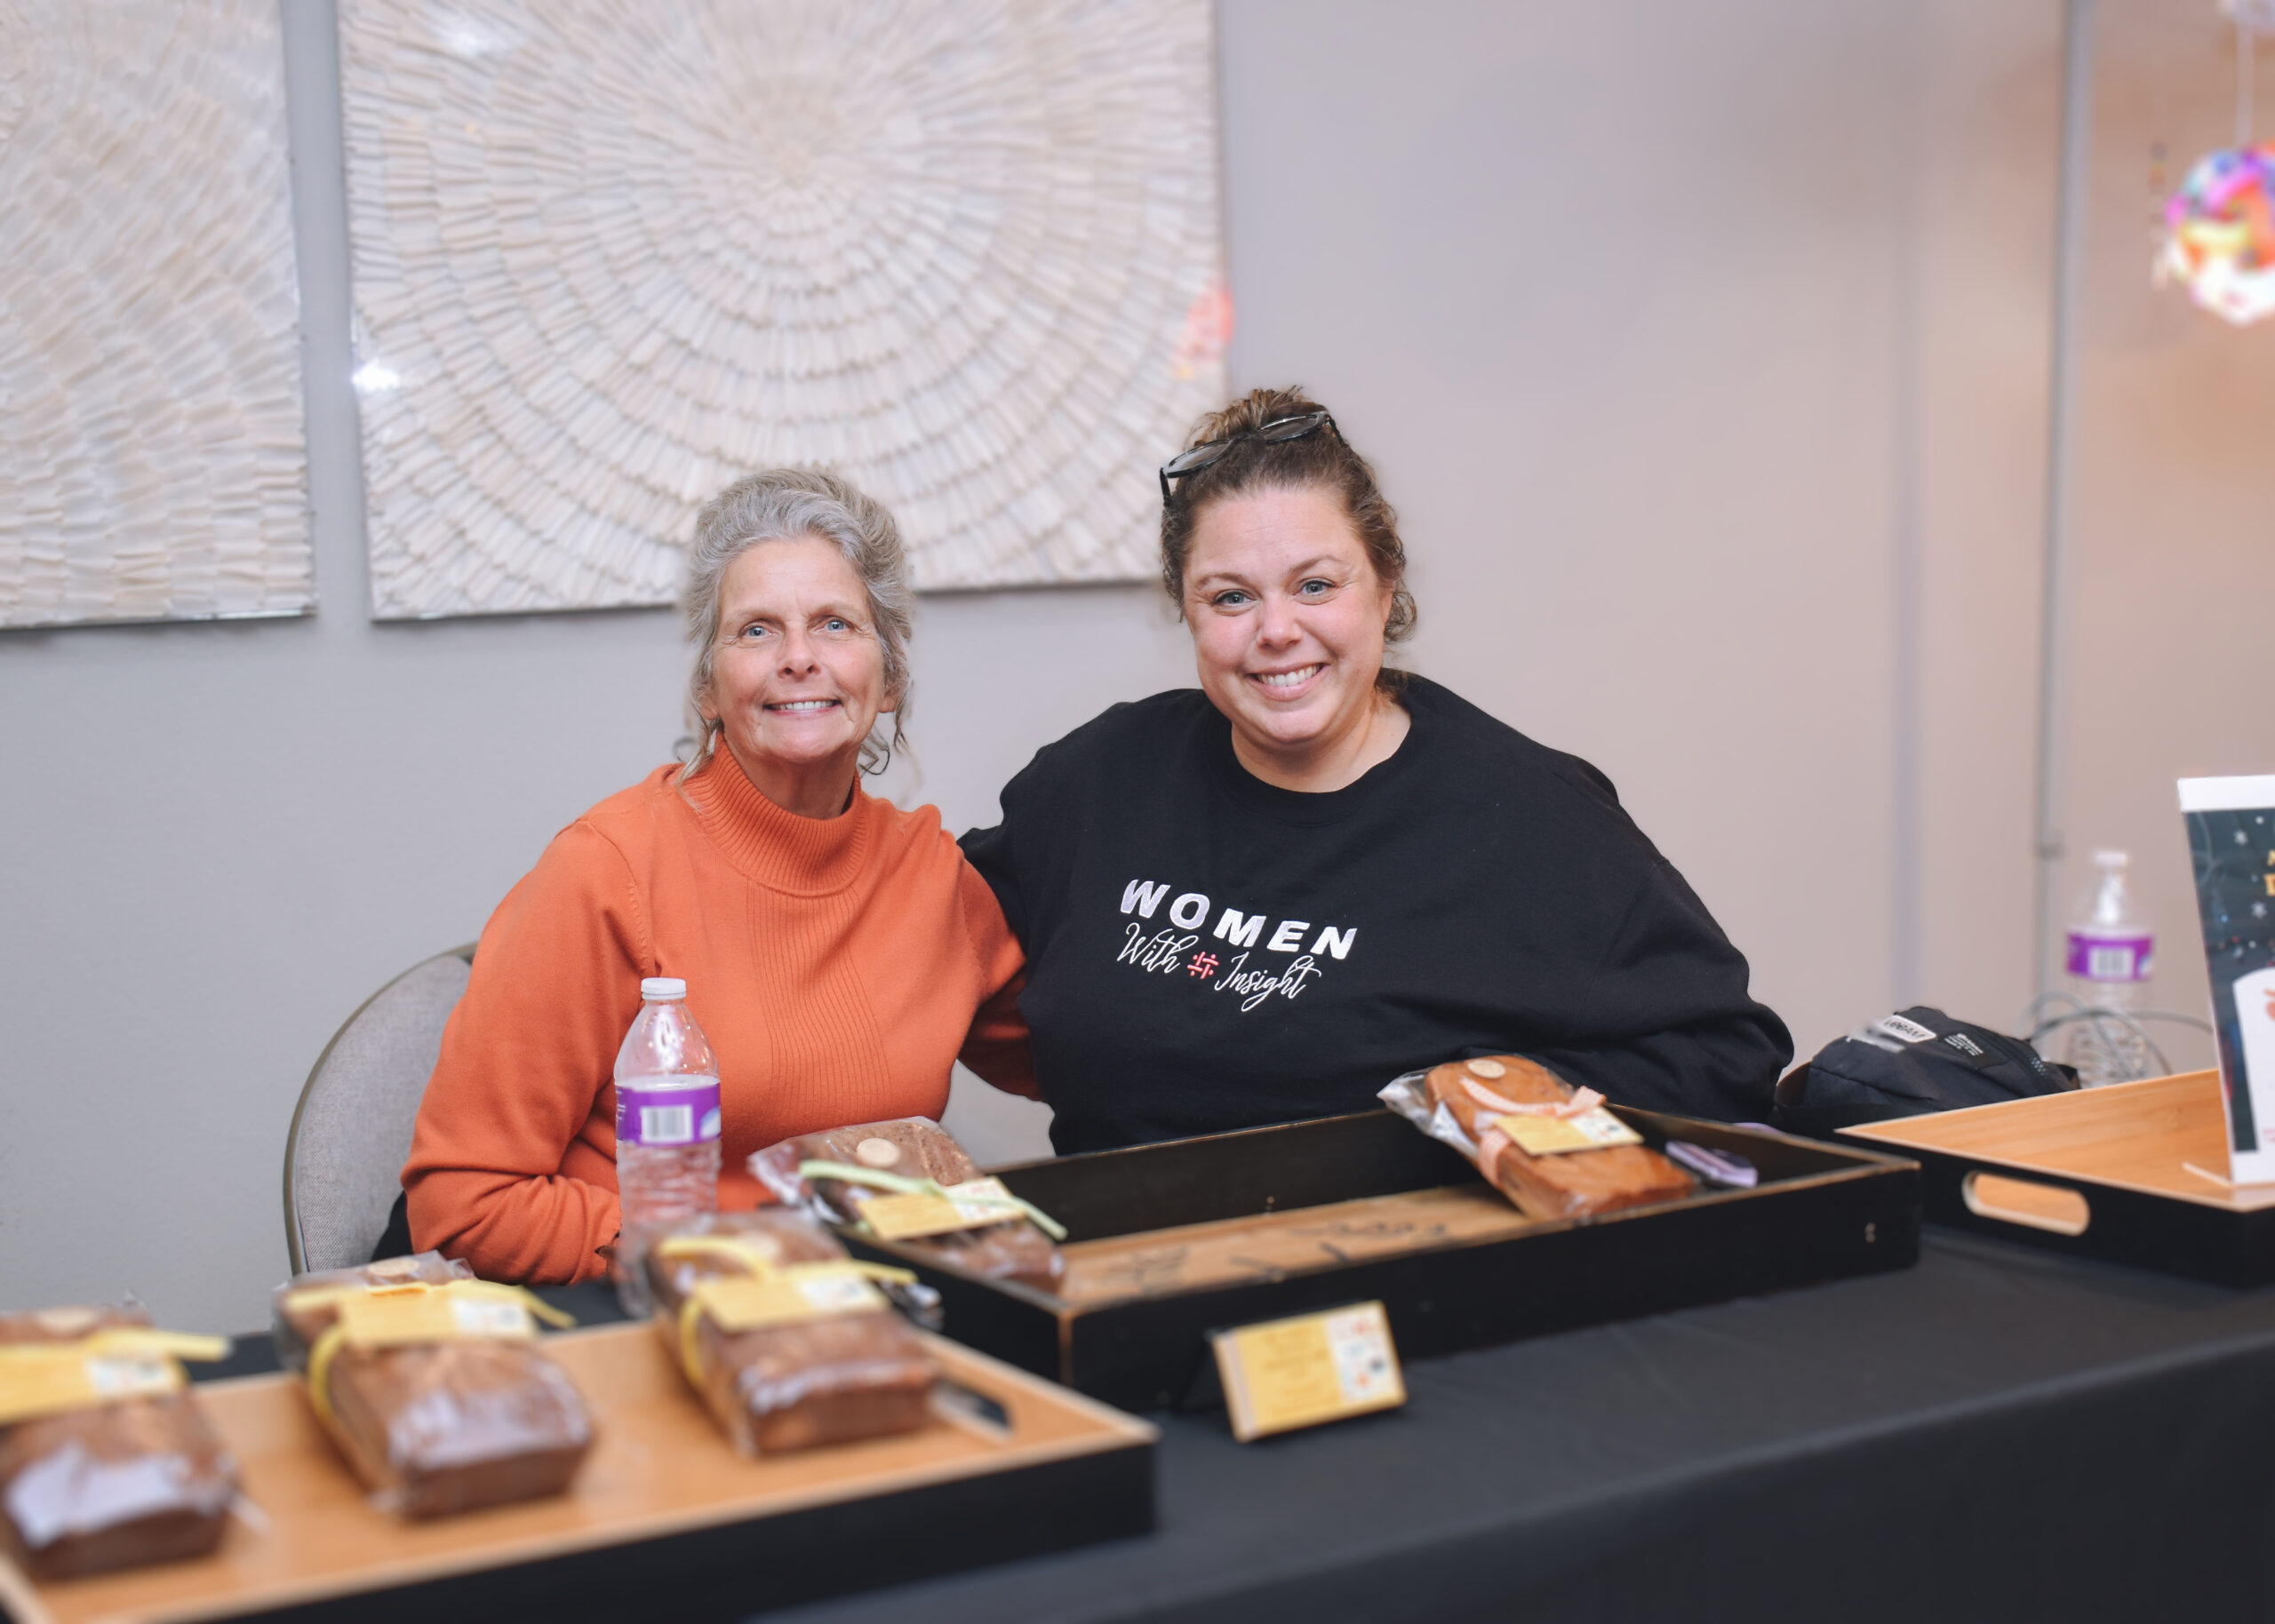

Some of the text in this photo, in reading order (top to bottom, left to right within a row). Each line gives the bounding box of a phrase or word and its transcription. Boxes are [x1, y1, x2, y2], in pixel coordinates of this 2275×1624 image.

[1120, 879, 1358, 960] WOMEN
[1116, 922, 1199, 974] With
[1214, 951, 1322, 1012] Insight
